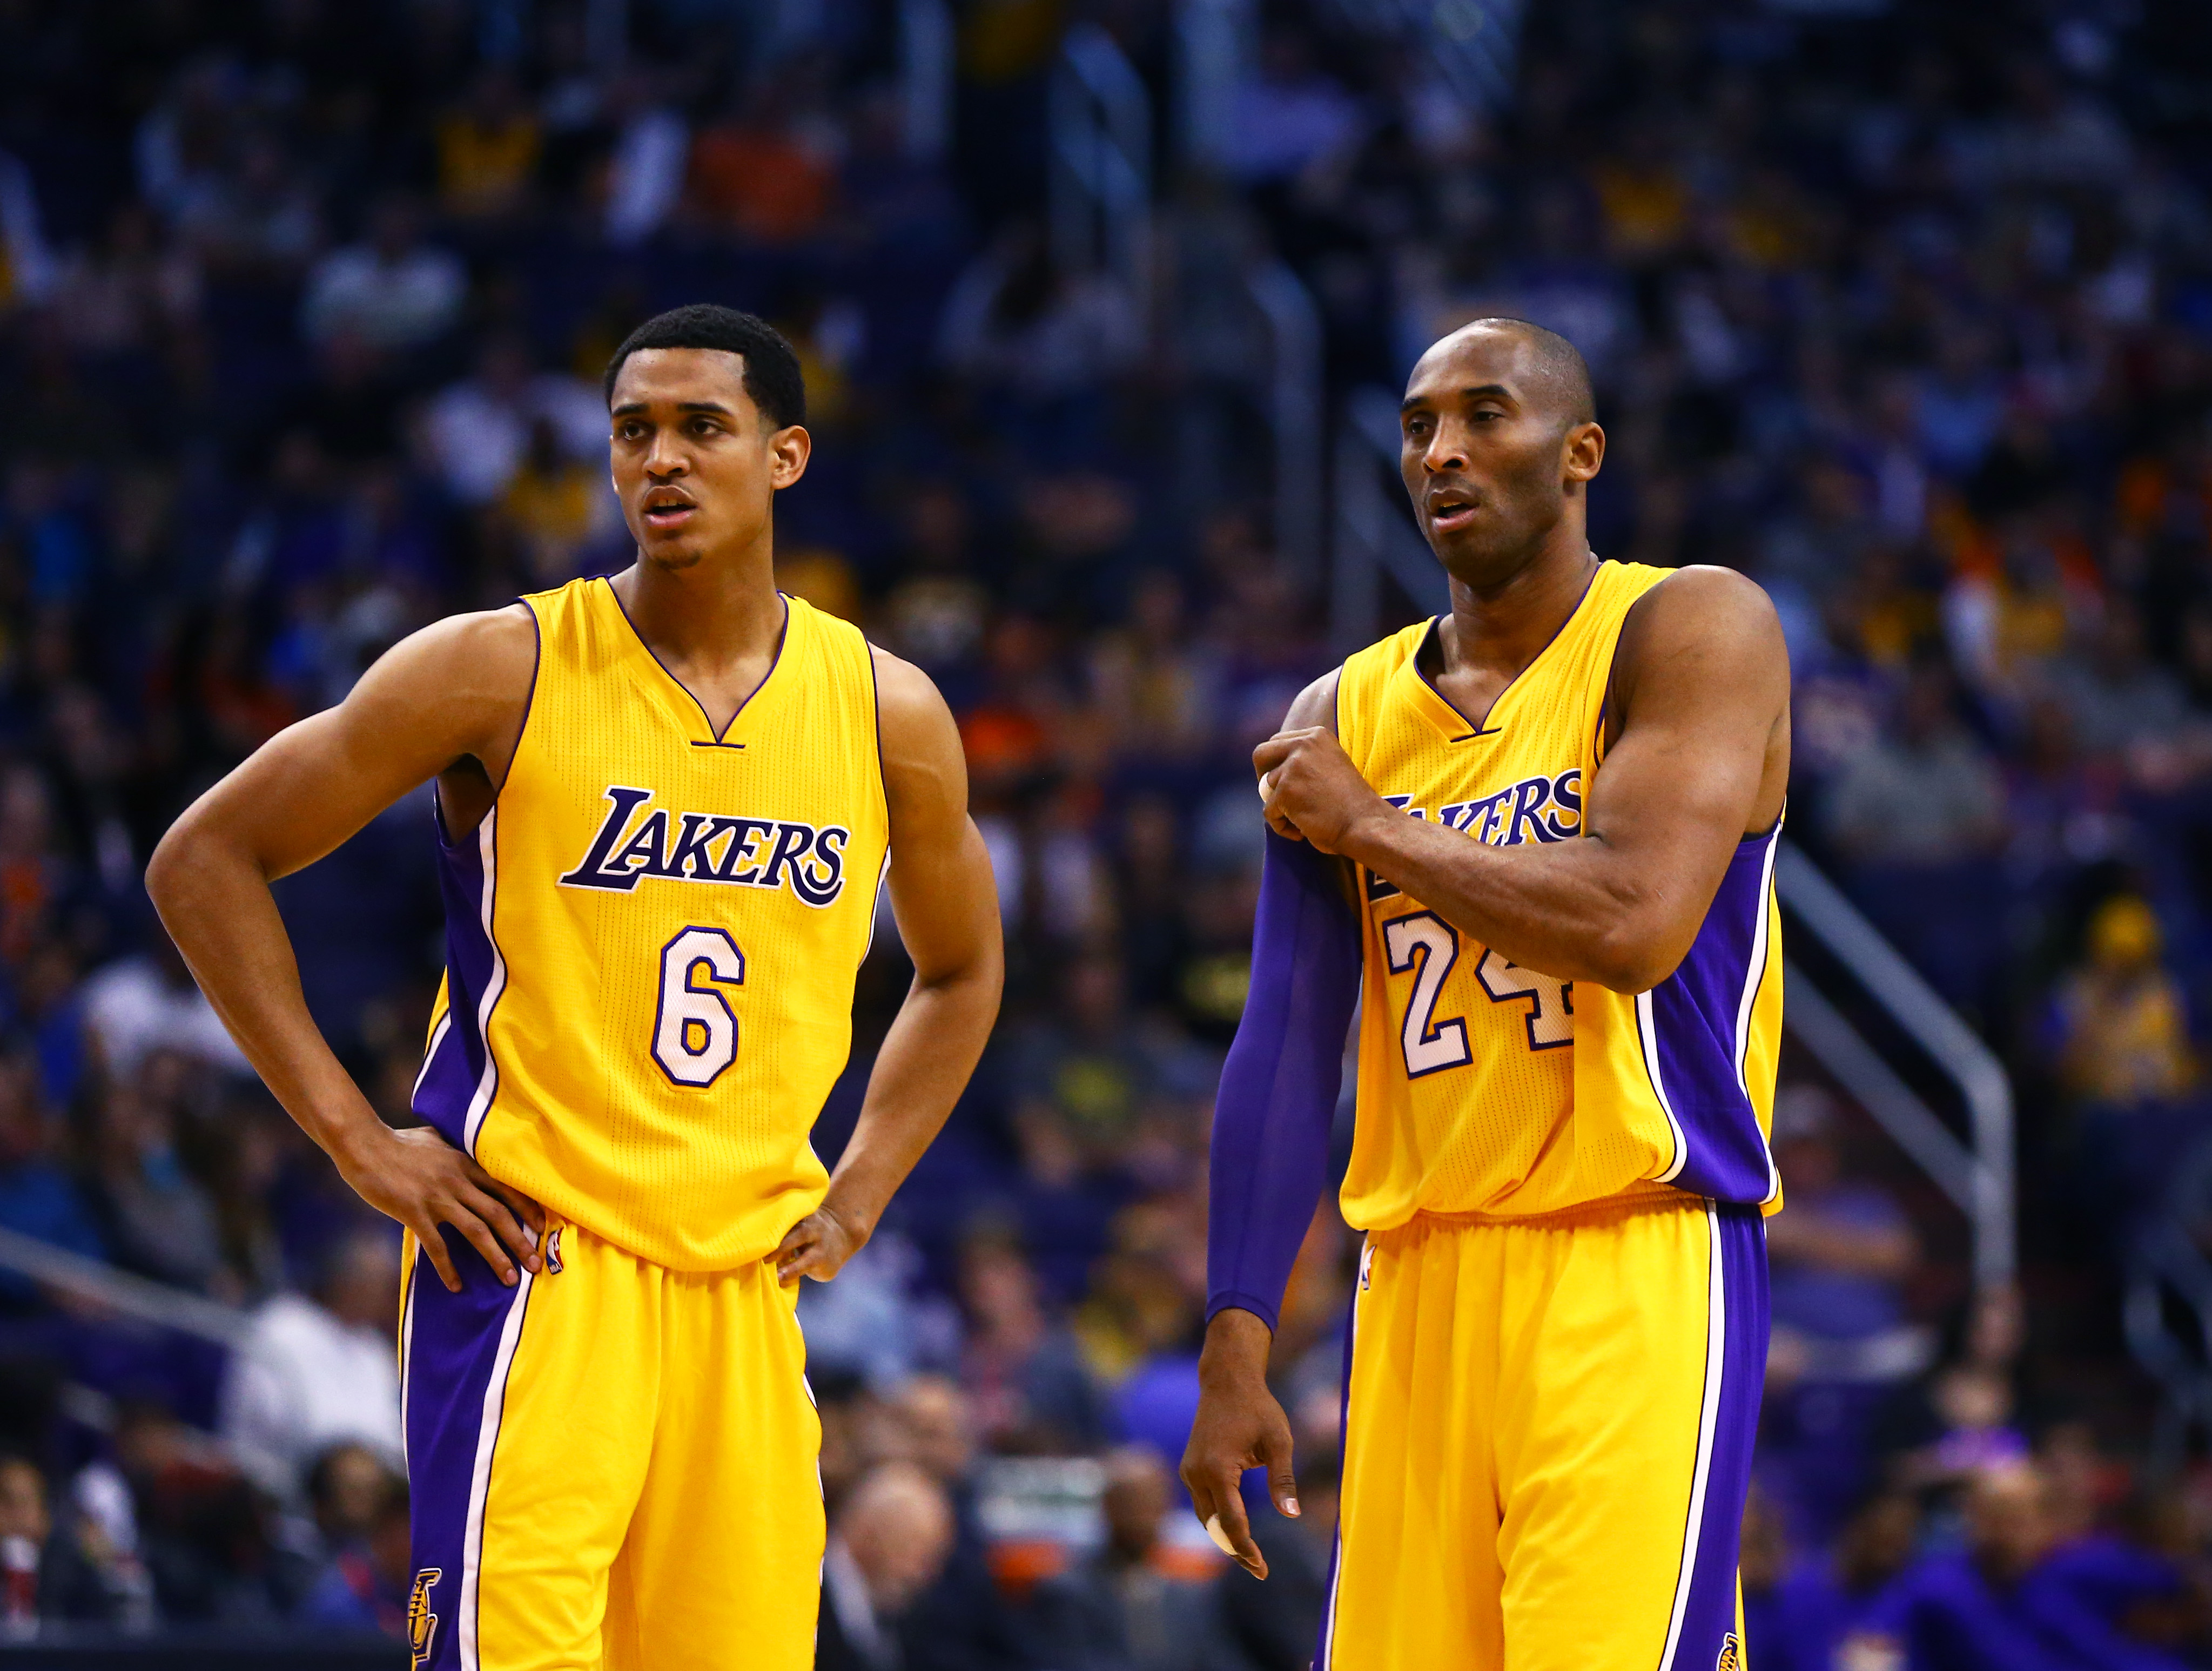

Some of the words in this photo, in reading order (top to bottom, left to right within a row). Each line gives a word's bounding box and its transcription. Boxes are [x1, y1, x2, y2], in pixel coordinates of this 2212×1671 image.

[556, 784, 852, 908] LAKERS
[650, 925, 745, 1088] 6
[1382, 909, 1574, 1080] 24
